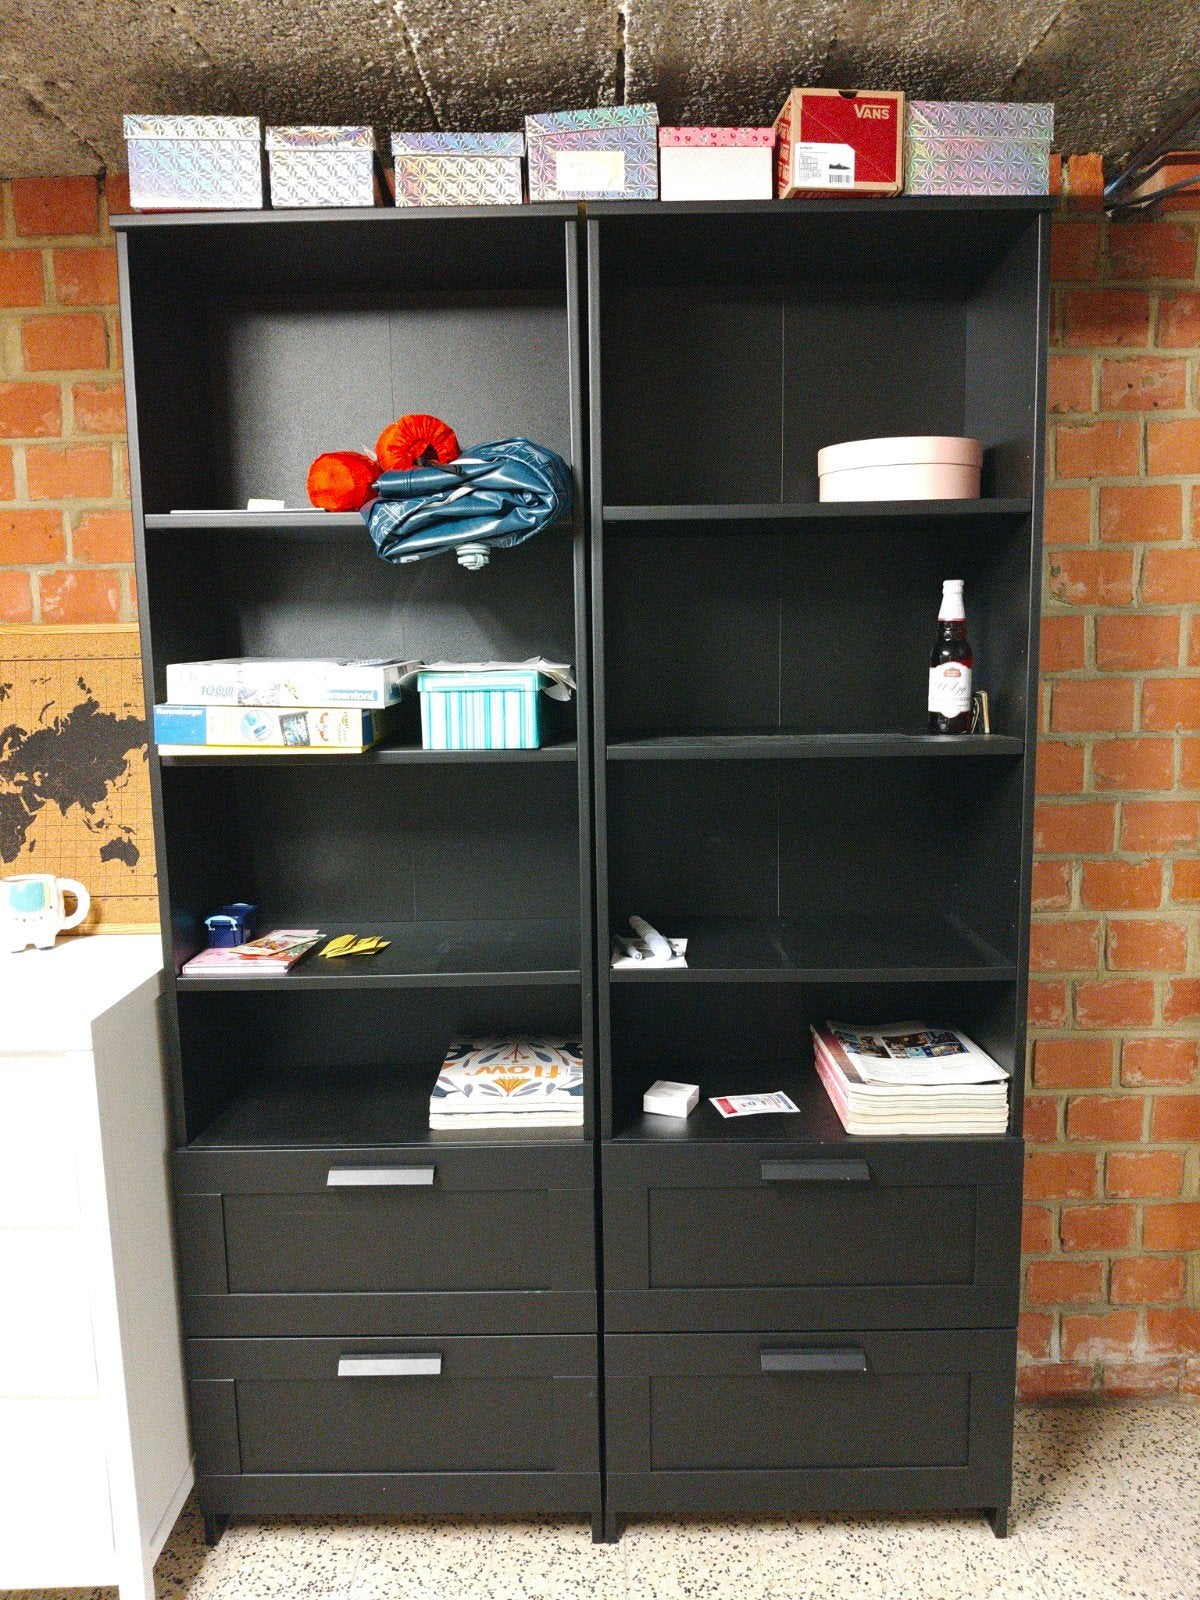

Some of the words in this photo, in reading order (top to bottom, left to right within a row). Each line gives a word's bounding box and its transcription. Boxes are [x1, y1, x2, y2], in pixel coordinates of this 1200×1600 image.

[853, 103, 891, 120] VANS
[200, 685, 234, 696] 1000
[464, 1063, 561, 1079] flow
